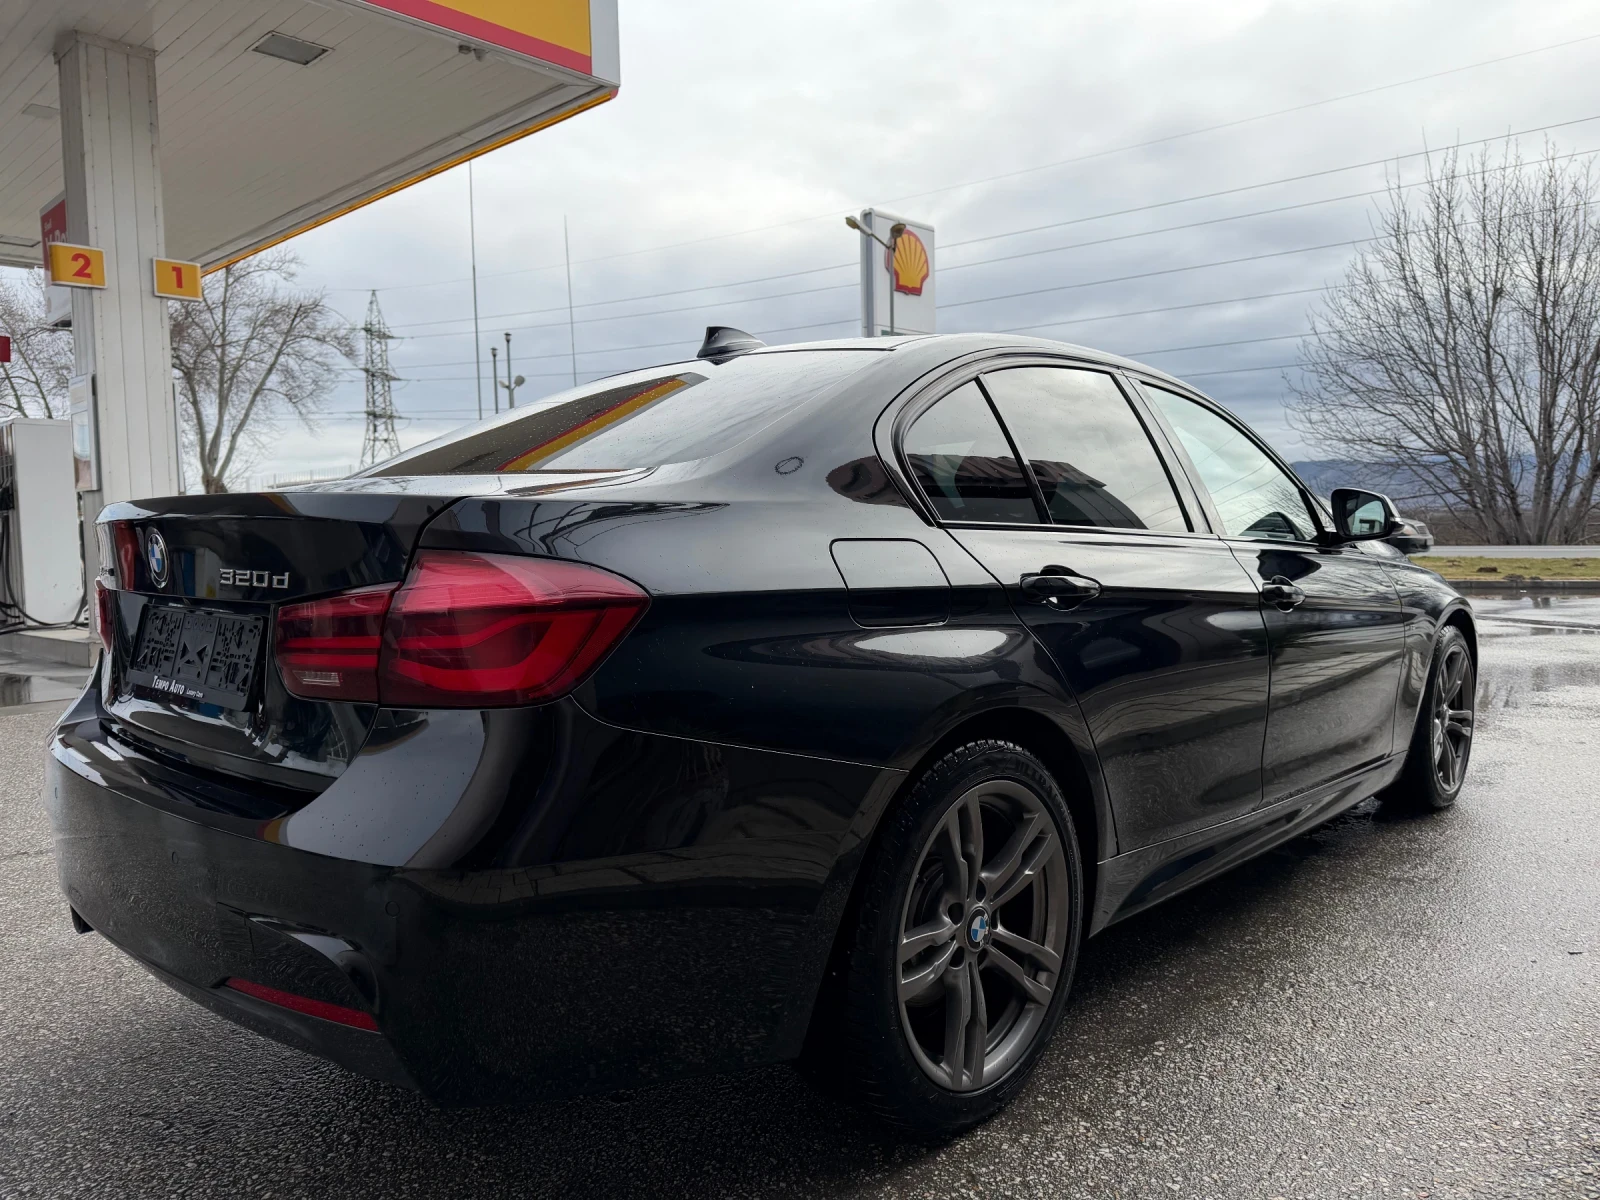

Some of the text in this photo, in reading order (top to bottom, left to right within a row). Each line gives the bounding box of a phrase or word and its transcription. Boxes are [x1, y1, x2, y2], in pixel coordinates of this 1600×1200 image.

[71, 253, 92, 279] 2
[172, 266, 183, 289] 1
[220, 568, 290, 589] 320d
[169, 680, 185, 695] AUTO
